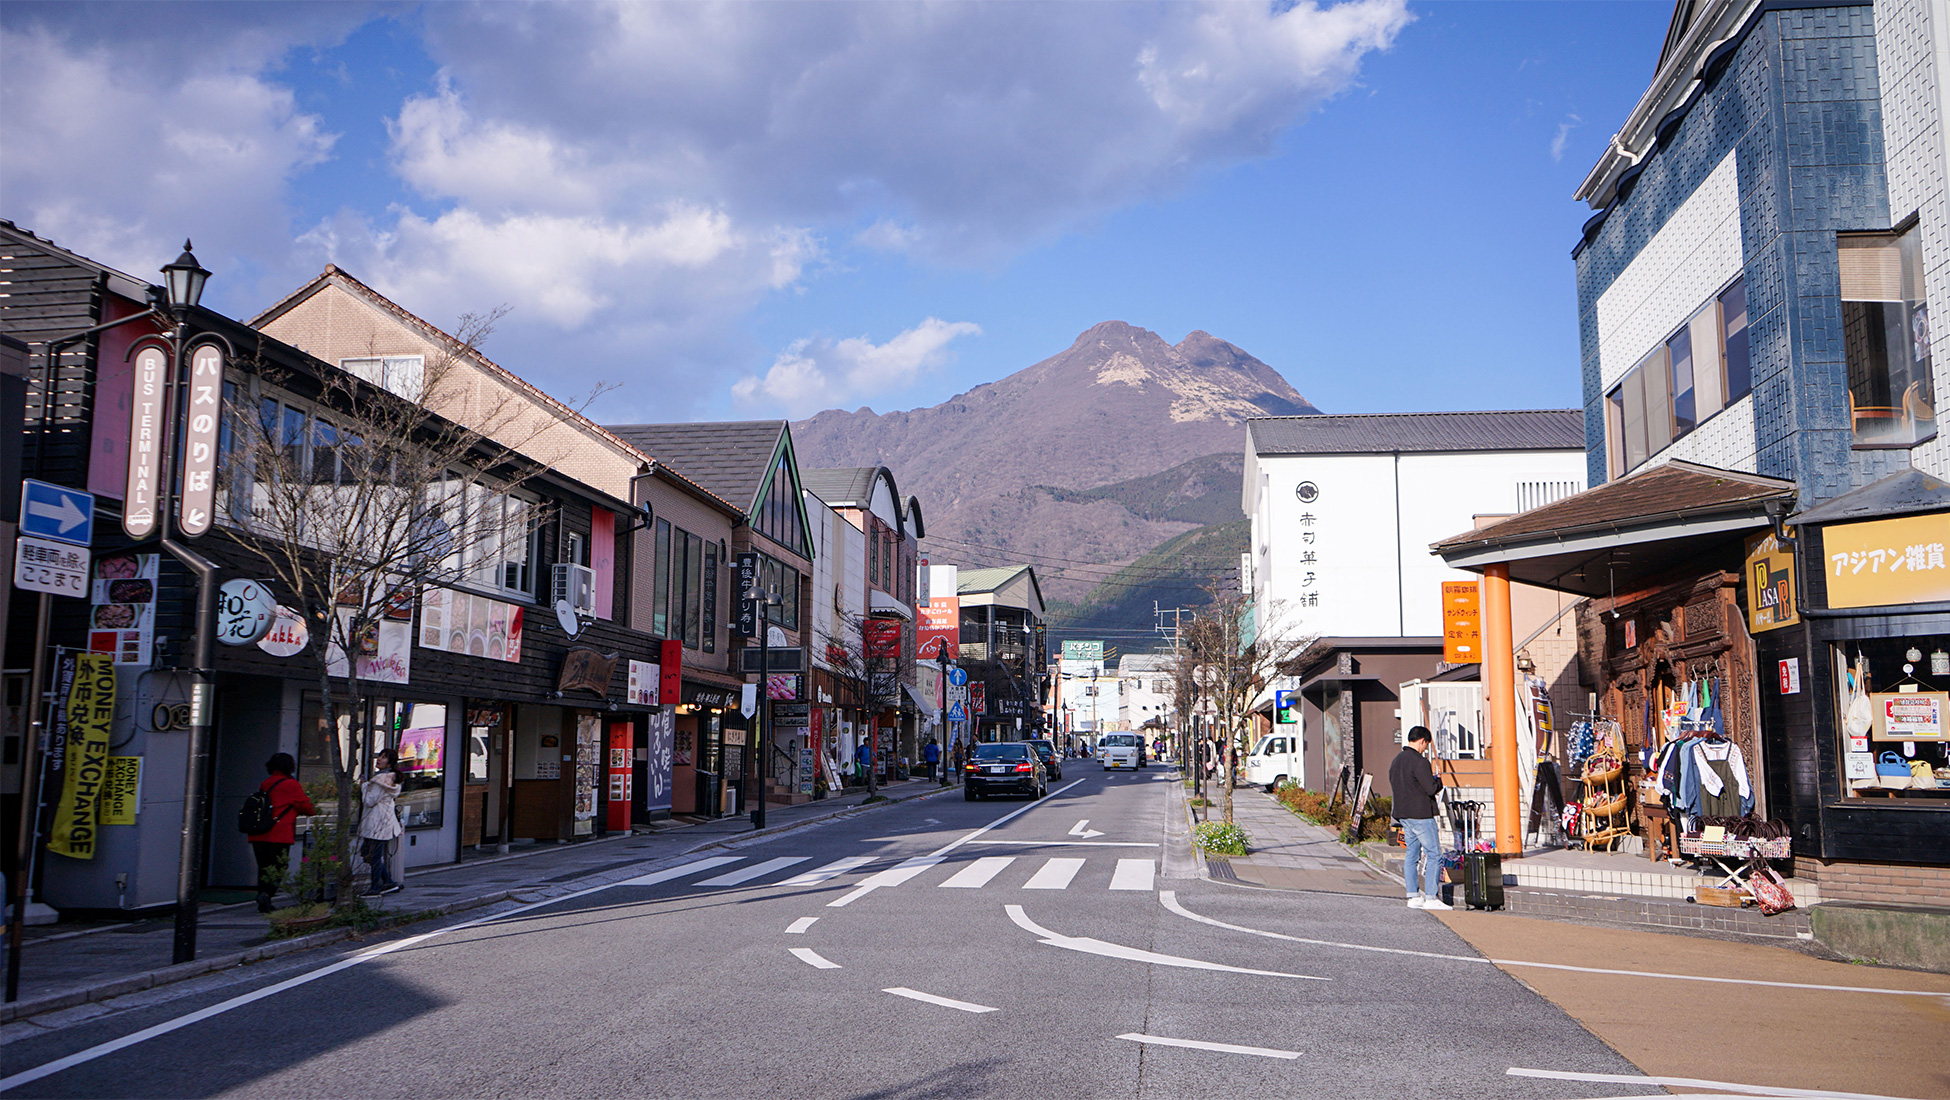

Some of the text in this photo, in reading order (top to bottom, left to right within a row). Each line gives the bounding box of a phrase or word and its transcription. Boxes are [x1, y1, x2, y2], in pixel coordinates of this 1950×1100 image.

[136, 358, 156, 504] BUS TERMINAL
[188, 357, 219, 492] バスのりば
[22, 544, 87, 571] 軽車両を除く
[22, 566, 82, 591] ここまで
[1299, 511, 1320, 608] 赤司菓子舗
[1831, 543, 1946, 577] アジアン雑貨
[740, 557, 753, 634] 豊後牛り寿し
[1755, 562, 1790, 620] PASAR
[1070, 642, 1101, 651] パチンコ
[154, 703, 192, 731] Ope
[69, 660, 114, 854] MONEY EXCHANGE
[125, 758, 138, 796] MONEY
[112, 758, 126, 817] EXCHANGE
